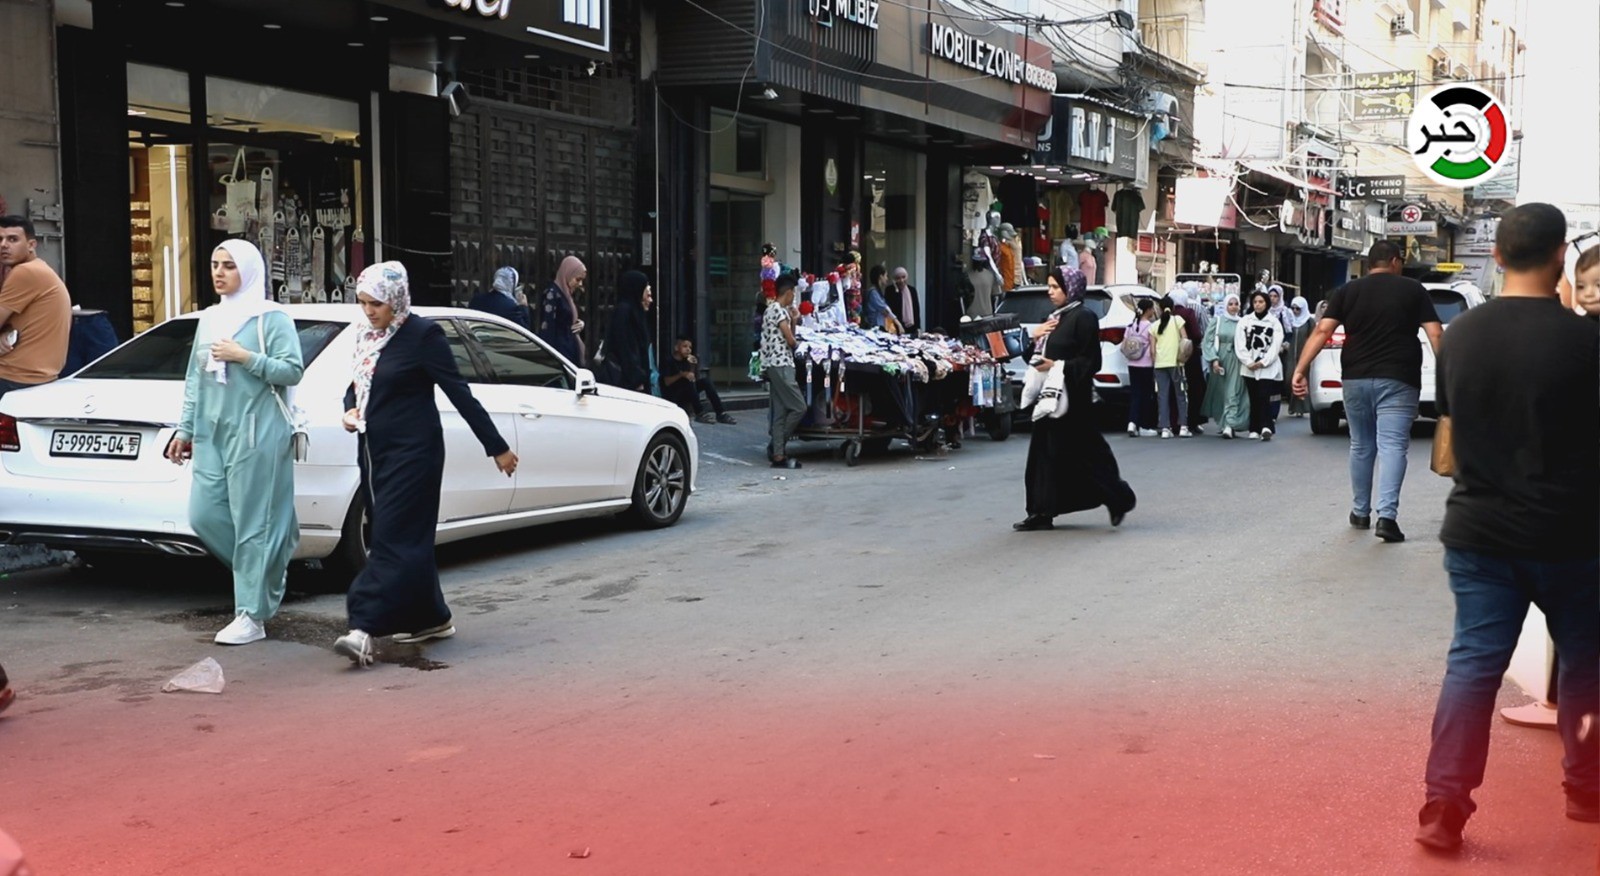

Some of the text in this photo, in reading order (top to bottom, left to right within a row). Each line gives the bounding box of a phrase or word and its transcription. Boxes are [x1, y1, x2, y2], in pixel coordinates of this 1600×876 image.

[931, 22, 1021, 84] MOBILE ZONE
[1036, 142, 1052, 152] NS
[1370, 188, 1400, 196] CENTER
[56, 434, 124, 453] 3-9995-04
